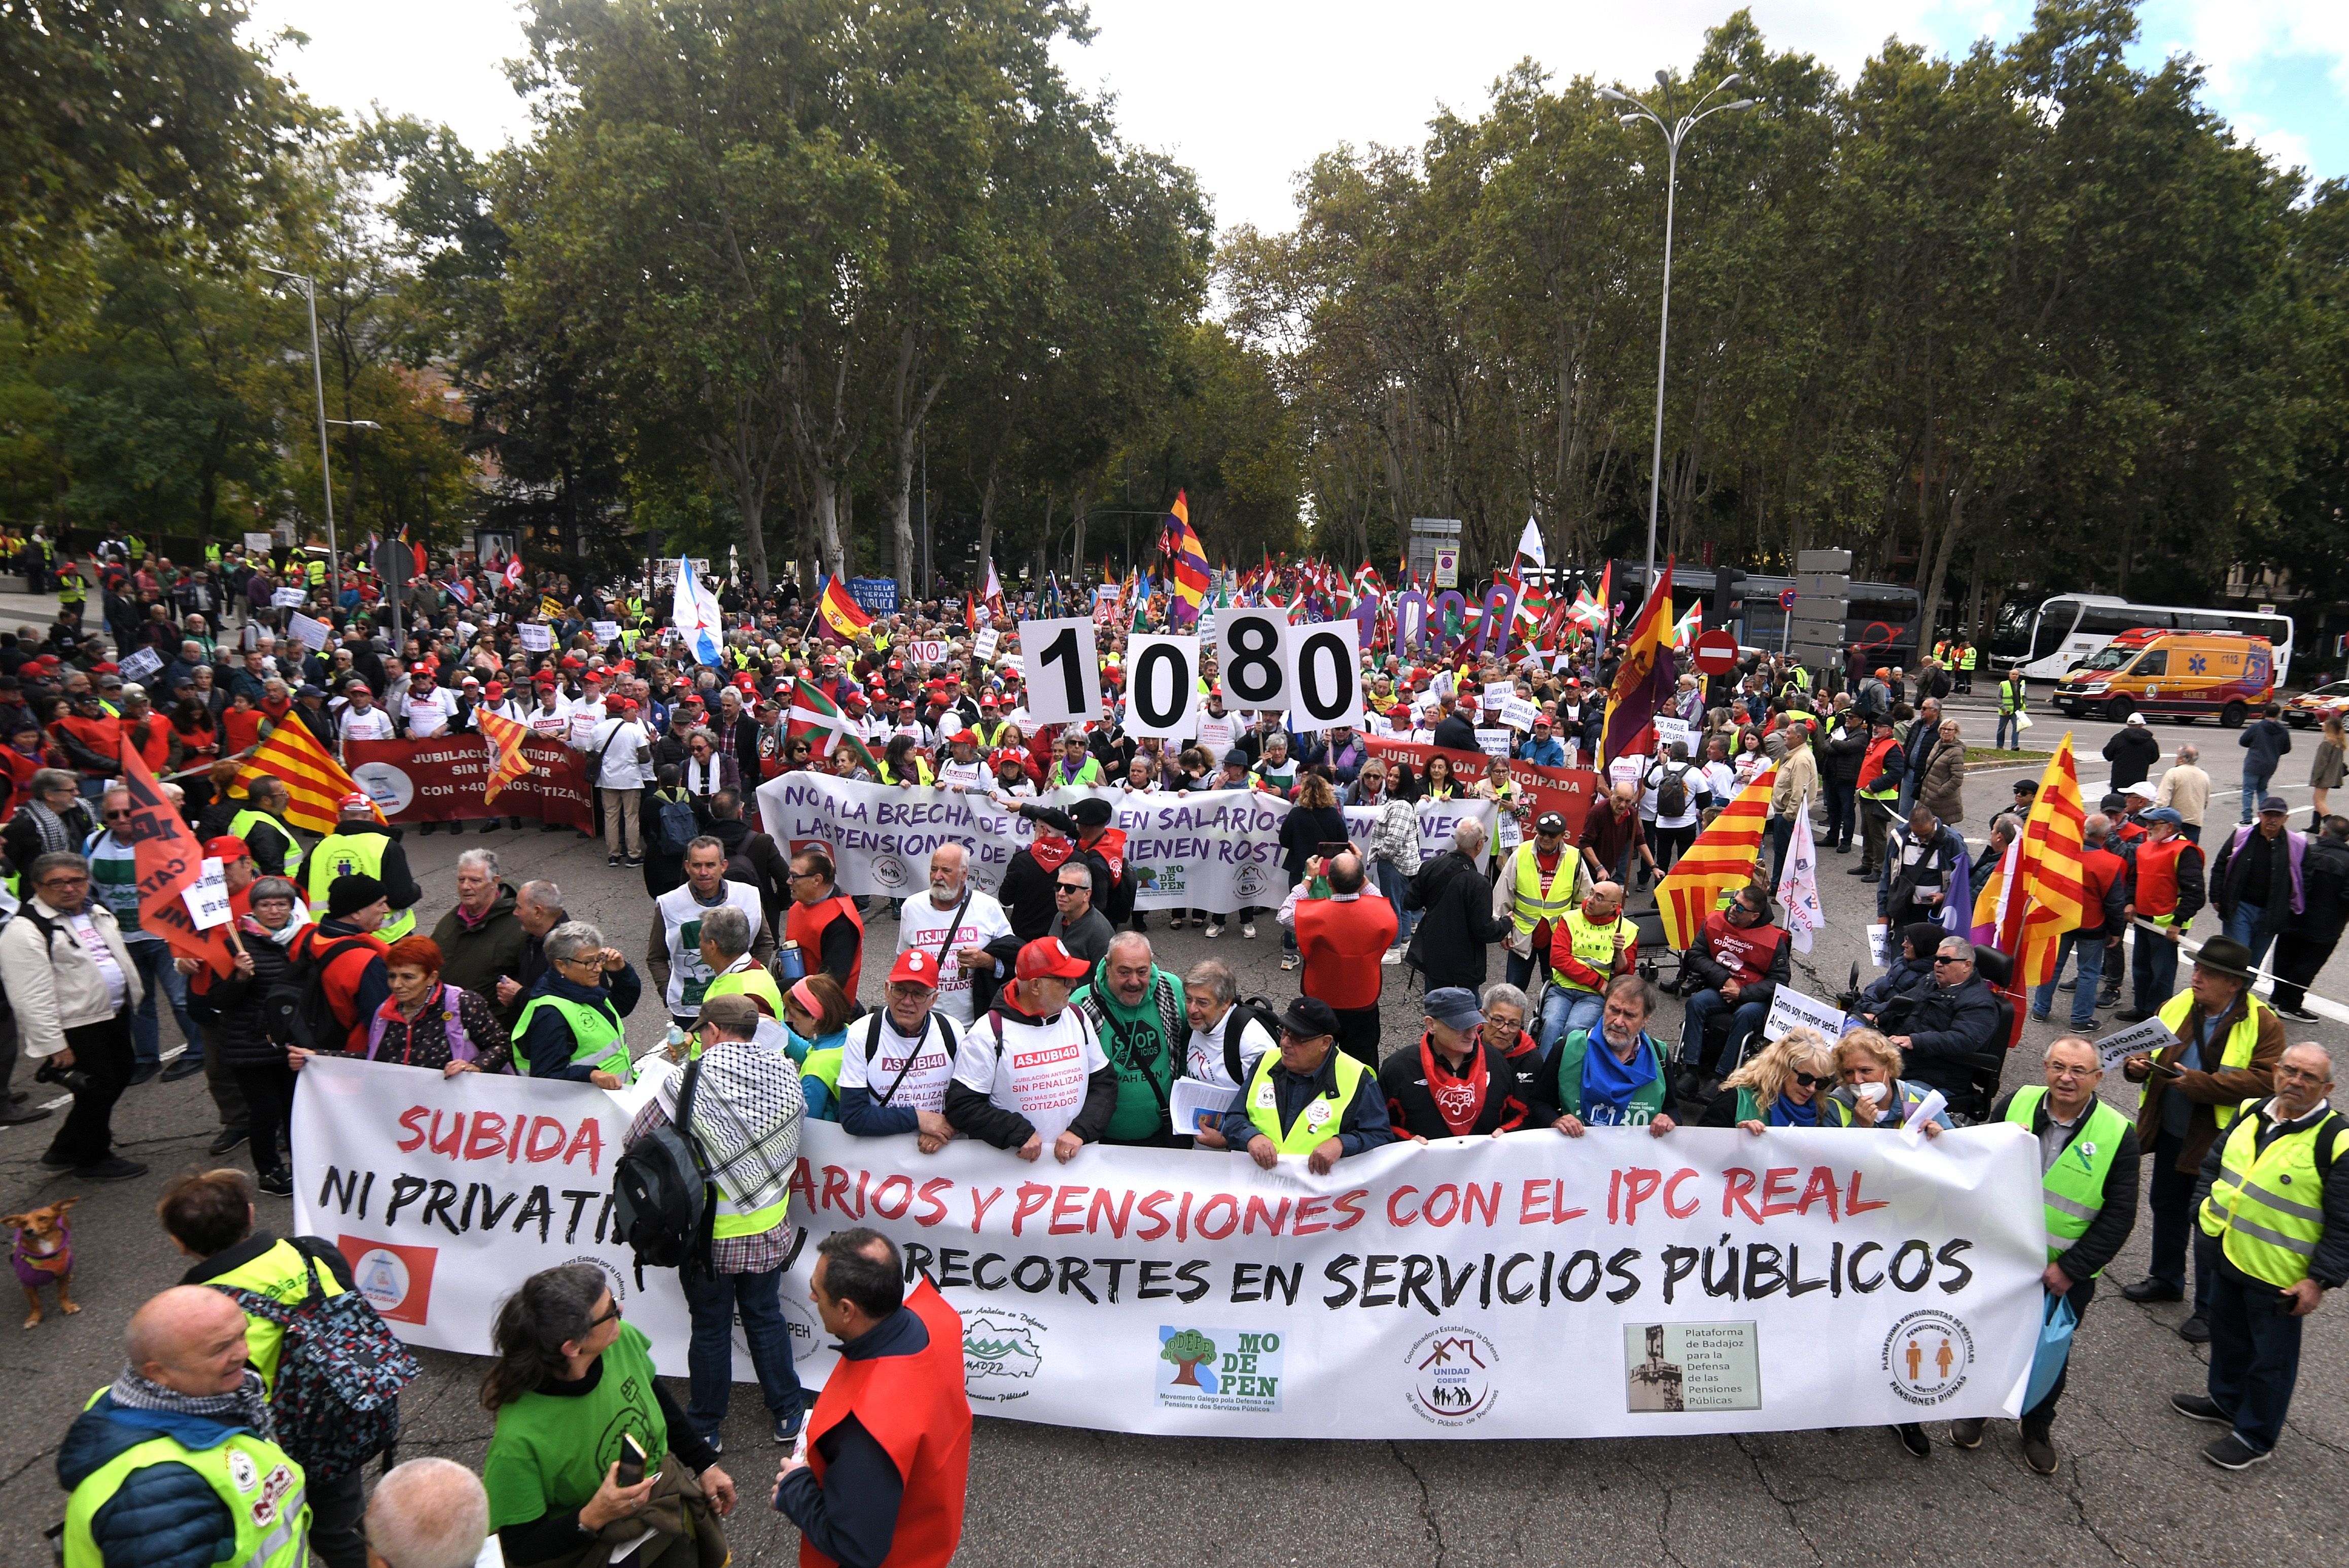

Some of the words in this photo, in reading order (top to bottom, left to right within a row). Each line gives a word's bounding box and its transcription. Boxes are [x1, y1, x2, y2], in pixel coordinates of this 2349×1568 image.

[1025, 592, 1034, 602] NO
[911, 642, 939, 662] NO
[1039, 627, 1086, 715] 1
[1134, 643, 1189, 728] 0
[1227, 616, 1283, 702] 8
[1299, 632, 1353, 721] 0
[2182, 691, 2207, 700] SAMUR
[451, 764, 478, 776] SIN
[946, 769, 978, 780] ASJUBI40
[420, 784, 454, 796] CON
[785, 785, 820, 807] NO
[824, 795, 835, 818] A
[842, 799, 868, 824] LA
[877, 803, 976, 832] BRECHA
[979, 816, 1008, 835] DE
[1119, 811, 1149, 830] EN
[796, 817, 836, 838] LAS
[980, 842, 1007, 863] DE
[1165, 865, 1184, 874] MO
[980, 877, 996, 886] MPEH
[1160, 874, 1176, 882] DE
[1160, 881, 1185, 890] PEN
[1722, 941, 1744, 954] Disgrup
[1724, 935, 1754, 951] Fundación
[939, 980, 974, 992] TIZADOS
[1768, 1014, 1777, 1027] Al
[1774, 994, 1791, 1013] Como
[1801, 1011, 1821, 1027] mayor
[1821, 1021, 1839, 1035] serás.
[1115, 1030, 1156, 1052] SOP
[2105, 1033, 2170, 1062] vaivenes!
[1015, 1046, 1078, 1067] ASJUBI40
[1012, 1084, 1029, 1092] SIN
[1032, 1073, 1084, 1091] PENALIZAR
[1015, 1073, 1049, 1083] JUBILACIÓN
[1051, 1067, 1081, 1077] ANTICIPADA
[914, 1080, 948, 1090] ANTICIPADA
[1022, 1096, 1078, 1111] COTIZADOS
[1450, 1092, 1471, 1102] MPB
[397, 1105, 606, 1176] SUBIDA
[788, 1156, 954, 1228] ARIOS
[971, 1186, 1004, 1234] Y
[1011, 1180, 1370, 1242] PENSIONES
[1387, 1181, 1503, 1228] CON
[1519, 1178, 1589, 1225] EL
[1606, 1166, 1701, 1226] IPC
[1721, 1166, 1890, 1226] REAL
[318, 1165, 376, 1220] NI
[902, 1242, 1212, 1305] RECORTES
[1230, 1262, 1305, 1306] EN
[1322, 1247, 1643, 1317] SERVICIOS
[1660, 1231, 1975, 1305] PÚBLICOS
[577, 1256, 600, 1264] Estatal
[599, 1260, 611, 1269] por
[613, 1272, 625, 1301] Defensa
[787, 1322, 811, 1339] PEH
[1685, 1328, 1743, 1337] Plataforma
[1906, 1324, 1952, 1339] PENSIONISTAS
[1164, 1333, 1213, 1361] MODEPEN
[1237, 1333, 1280, 1353] MO
[1404, 1329, 1440, 1365] Coordinadora
[1439, 1325, 1464, 1333] Estatal
[1463, 1328, 1477, 1336] por
[1476, 1332, 1483, 1340] la
[1482, 1336, 1500, 1363] Defensa
[1702, 1340, 1744, 1349] Badajoz
[1881, 1322, 1901, 1371] PLATAFORMA
[1899, 1309, 1954, 1325] PENSIONISTAS
[1953, 1318, 1962, 1328] DE
[1961, 1327, 1975, 1364] MÓSTOLES
[964, 1360, 1004, 1373] MADPP
[1221, 1353, 1258, 1374] DE
[1688, 1363, 1730, 1371] Defensa
[1219, 1375, 1279, 1397] PEN
[1689, 1385, 1742, 1393] Pensiones
[1889, 1380, 1936, 1406] PENSIONES
[1938, 1375, 1967, 1403] DIGNAS
[997, 1390, 1029, 1403] Públicas
[1160, 1392, 1196, 1402] Movemento
[1197, 1395, 1219, 1404] Galego
[1220, 1397, 1234, 1405] pola
[1164, 1401, 1193, 1409] Pensións
[1213, 1402, 1241, 1411] Servizos
[1242, 1404, 1270, 1413] Públicos
[1405, 1391, 1415, 1403] del
[1412, 1403, 1435, 1423] Sistema
[1437, 1419, 1463, 1427] Público
[1476, 1389, 1499, 1420] Pensiones
